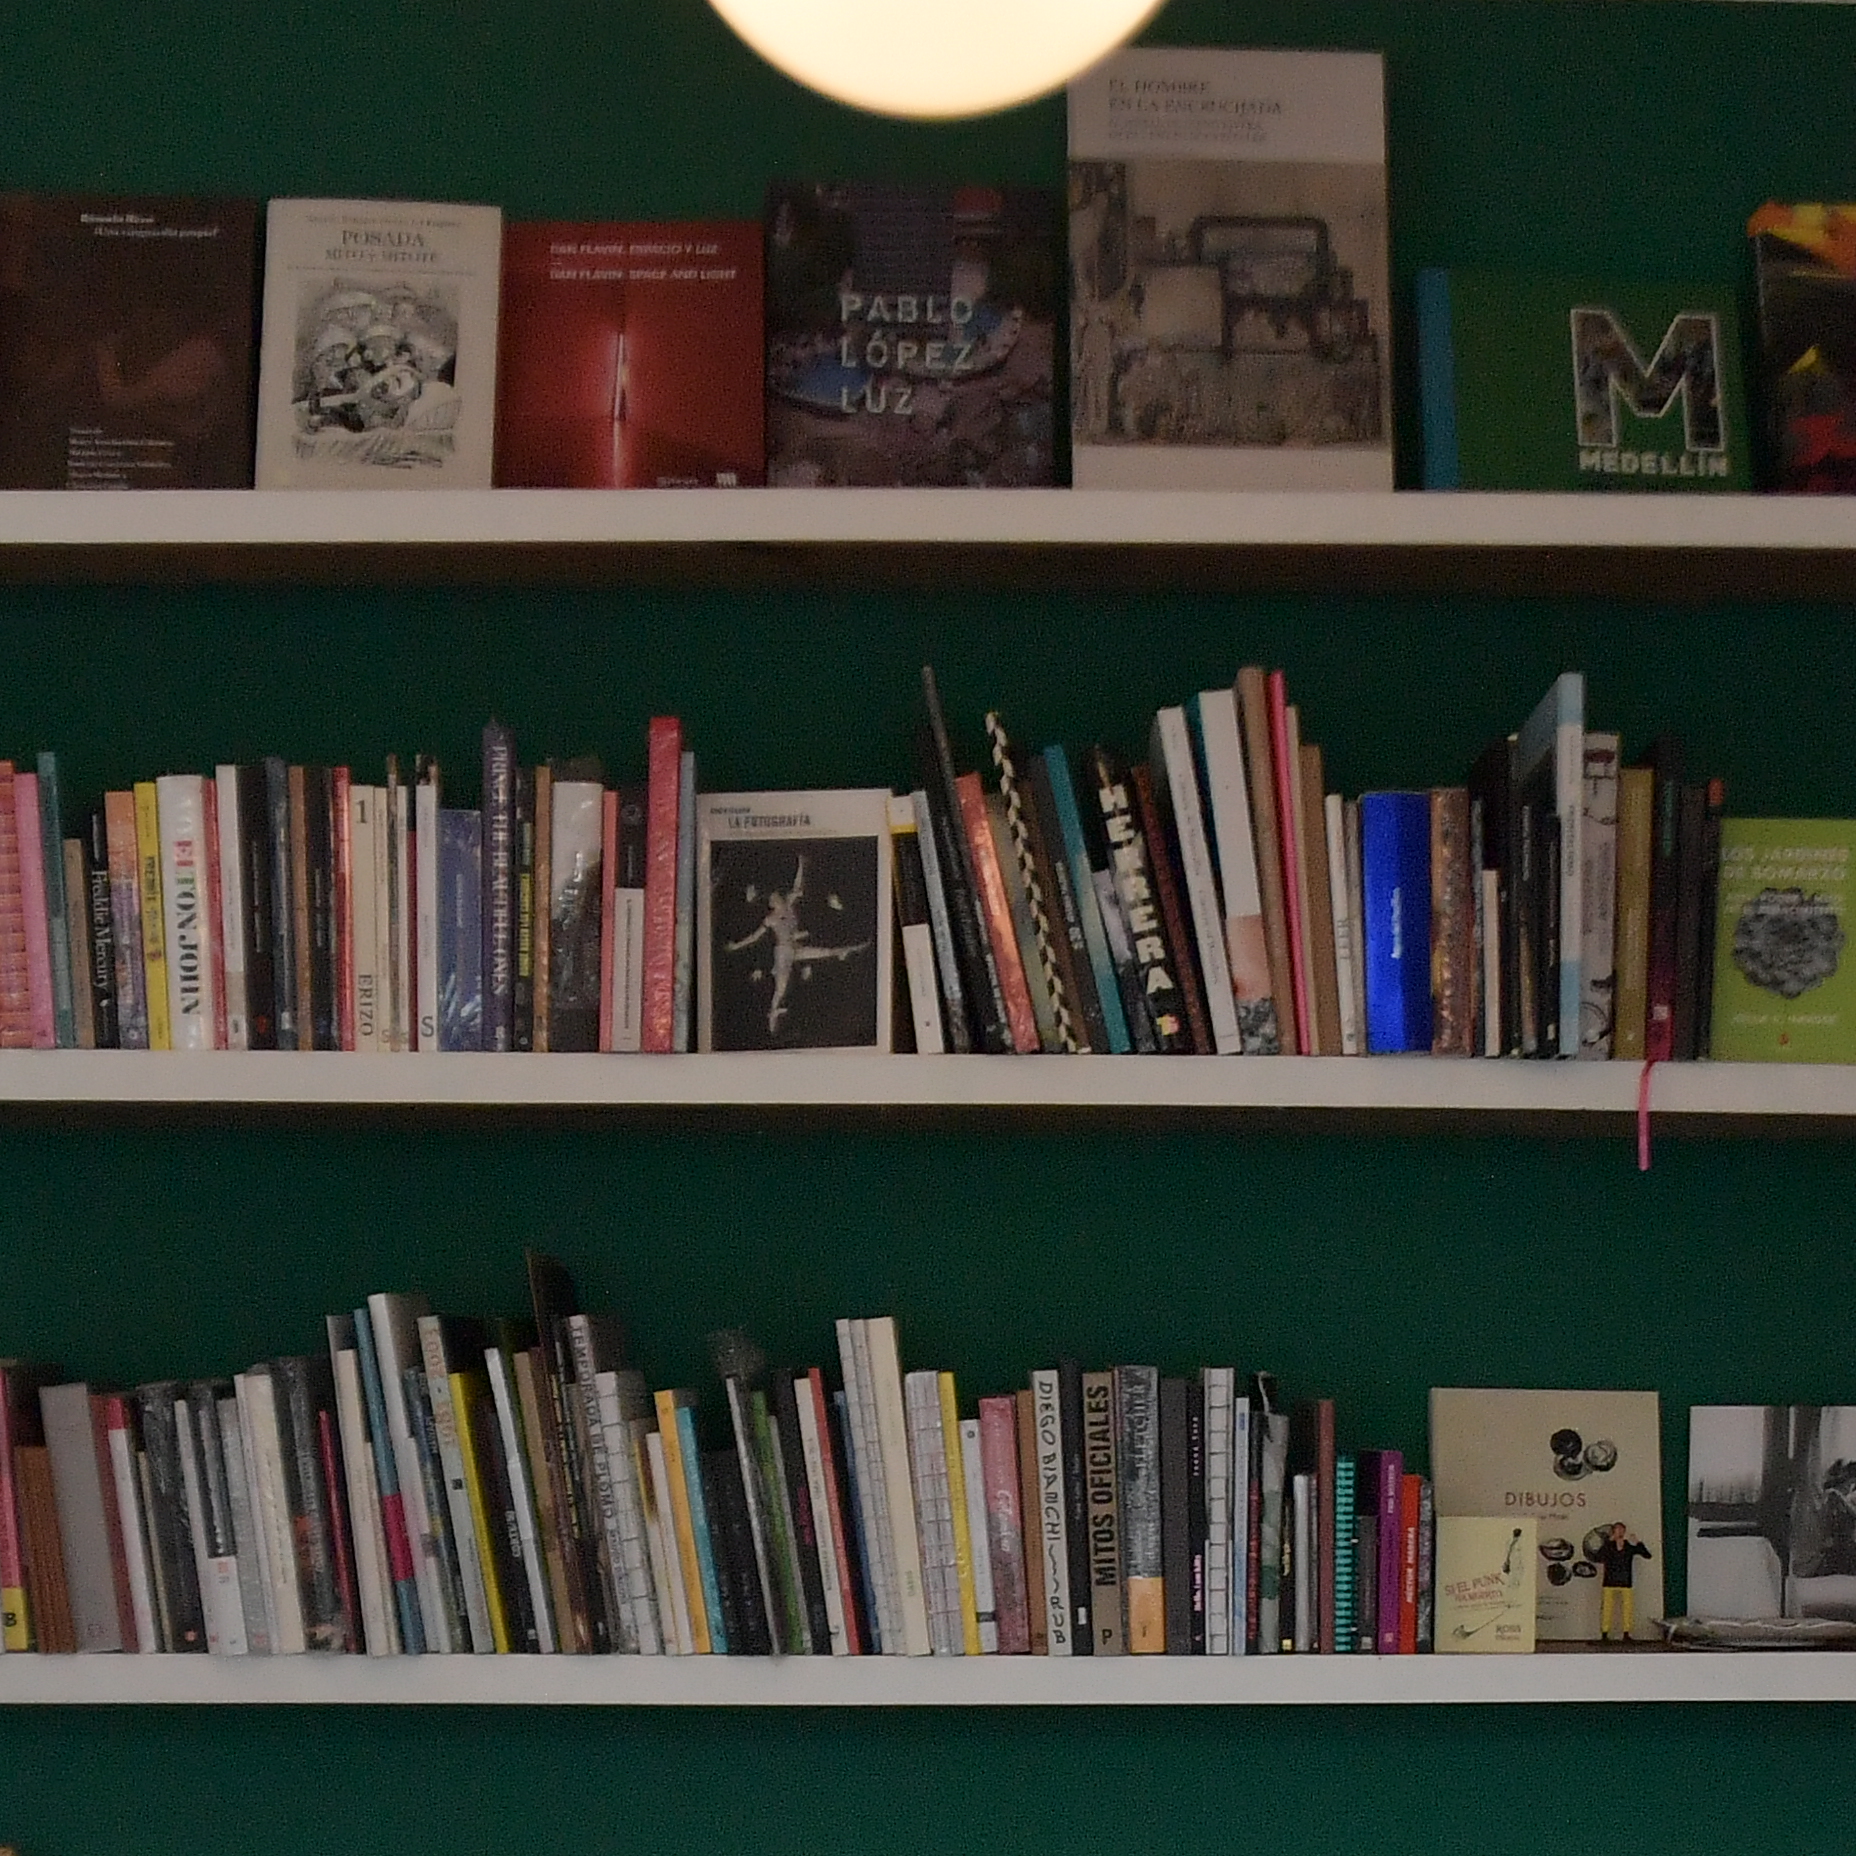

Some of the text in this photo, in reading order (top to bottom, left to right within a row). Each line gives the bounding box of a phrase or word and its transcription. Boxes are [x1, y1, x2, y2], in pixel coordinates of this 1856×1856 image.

[342, 229, 425, 248] POSADA
[840, 293, 975, 326] PABLO
[840, 326, 976, 371] LÓPEZ
[840, 384, 913, 416] LUZ
[92, 925, 113, 992] Mercury
[174, 839, 201, 1016] ELTON JOHN
[358, 973, 374, 1038] ERIZO
[571, 1324, 599, 1429] TEMPORADA
[593, 1459, 613, 1520] PLOMO
[1037, 1380, 1061, 1541] DIEGO BIANCHI
[1085, 1384, 1117, 1586] MITOS OFICIALES
[1504, 1490, 1587, 1508] DIBUJOS
